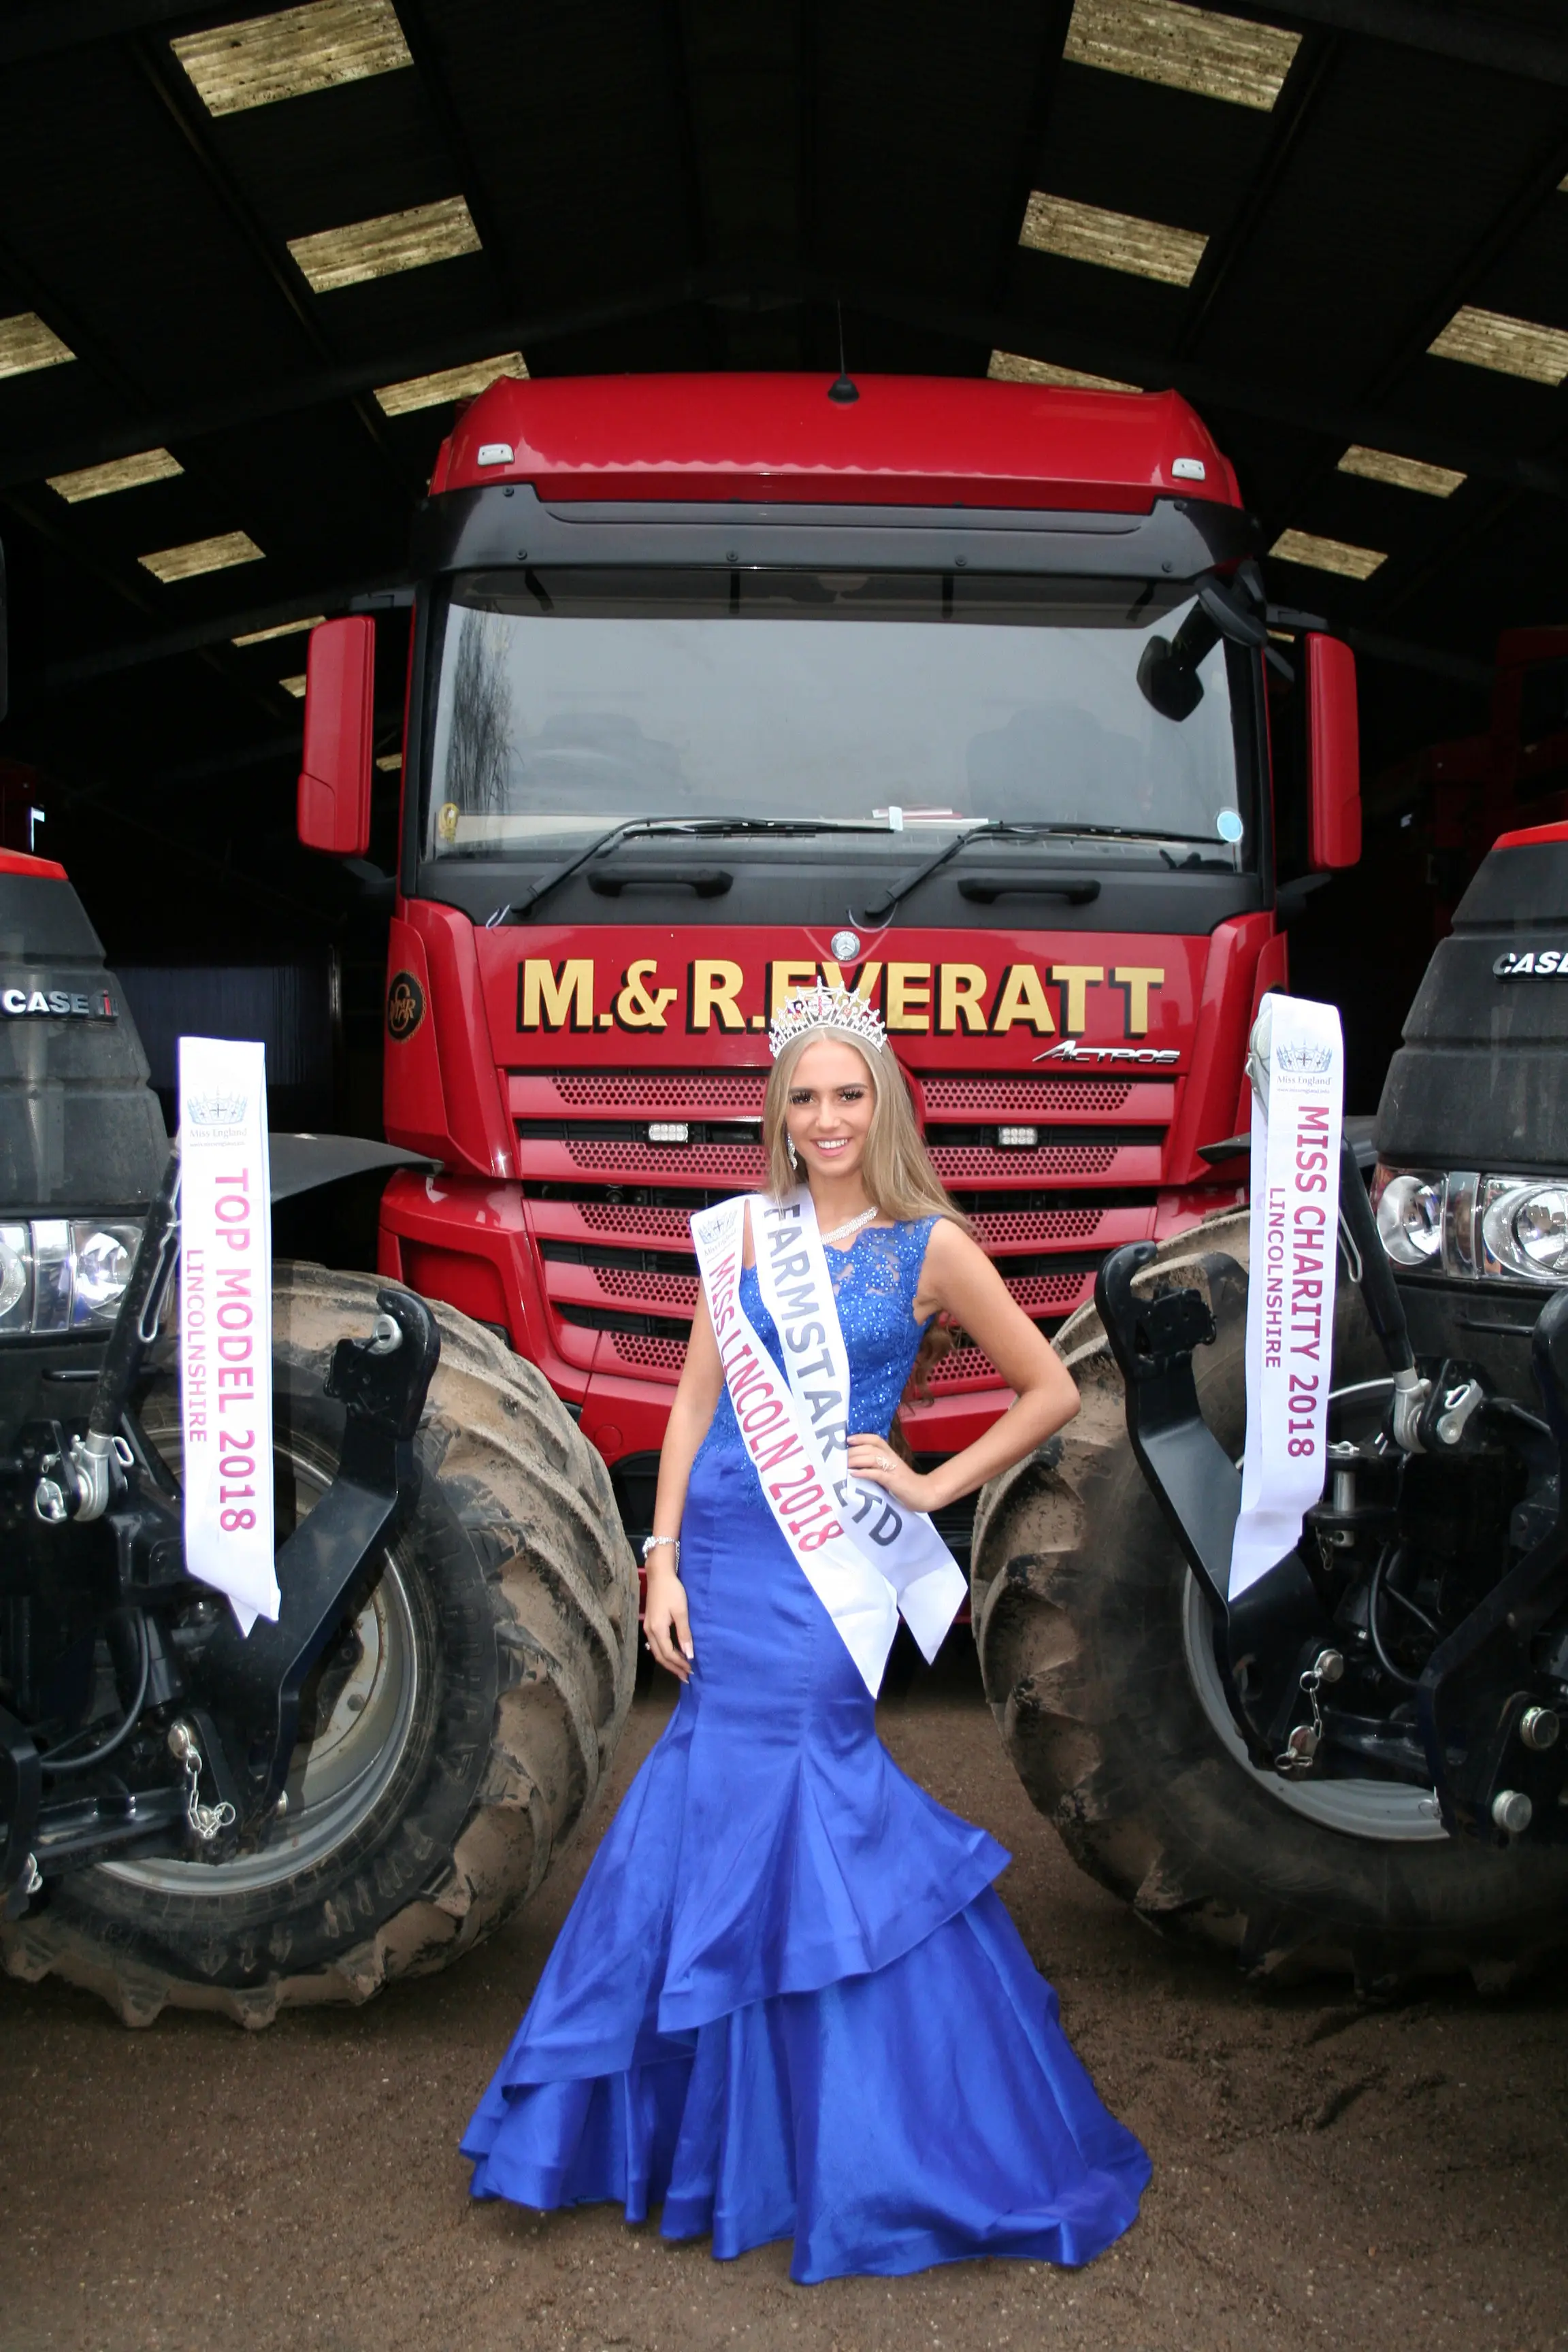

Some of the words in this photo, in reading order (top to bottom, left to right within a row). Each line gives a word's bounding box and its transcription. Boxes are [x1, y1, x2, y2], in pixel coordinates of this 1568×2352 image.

[3, 989, 90, 1014] CASE
[1294, 1106, 1329, 1192] MISS
[214, 1167, 250, 1252] TOP
[708, 1251, 736, 1338] MISS
[1265, 1187, 1286, 1369] LINCOLNSHIRE
[1289, 1205, 1326, 1362] CHARITY
[186, 1250, 208, 1443] LINCOLNSHIRE
[215, 1268, 255, 1414] MODEL
[763, 1203, 848, 1463] FARMSTAR
[721, 1328, 804, 1474] LINCOLN
[1287, 1374, 1319, 1458] 2018
[218, 1430, 257, 1532] 2018
[768, 1464, 845, 1552] 2018
